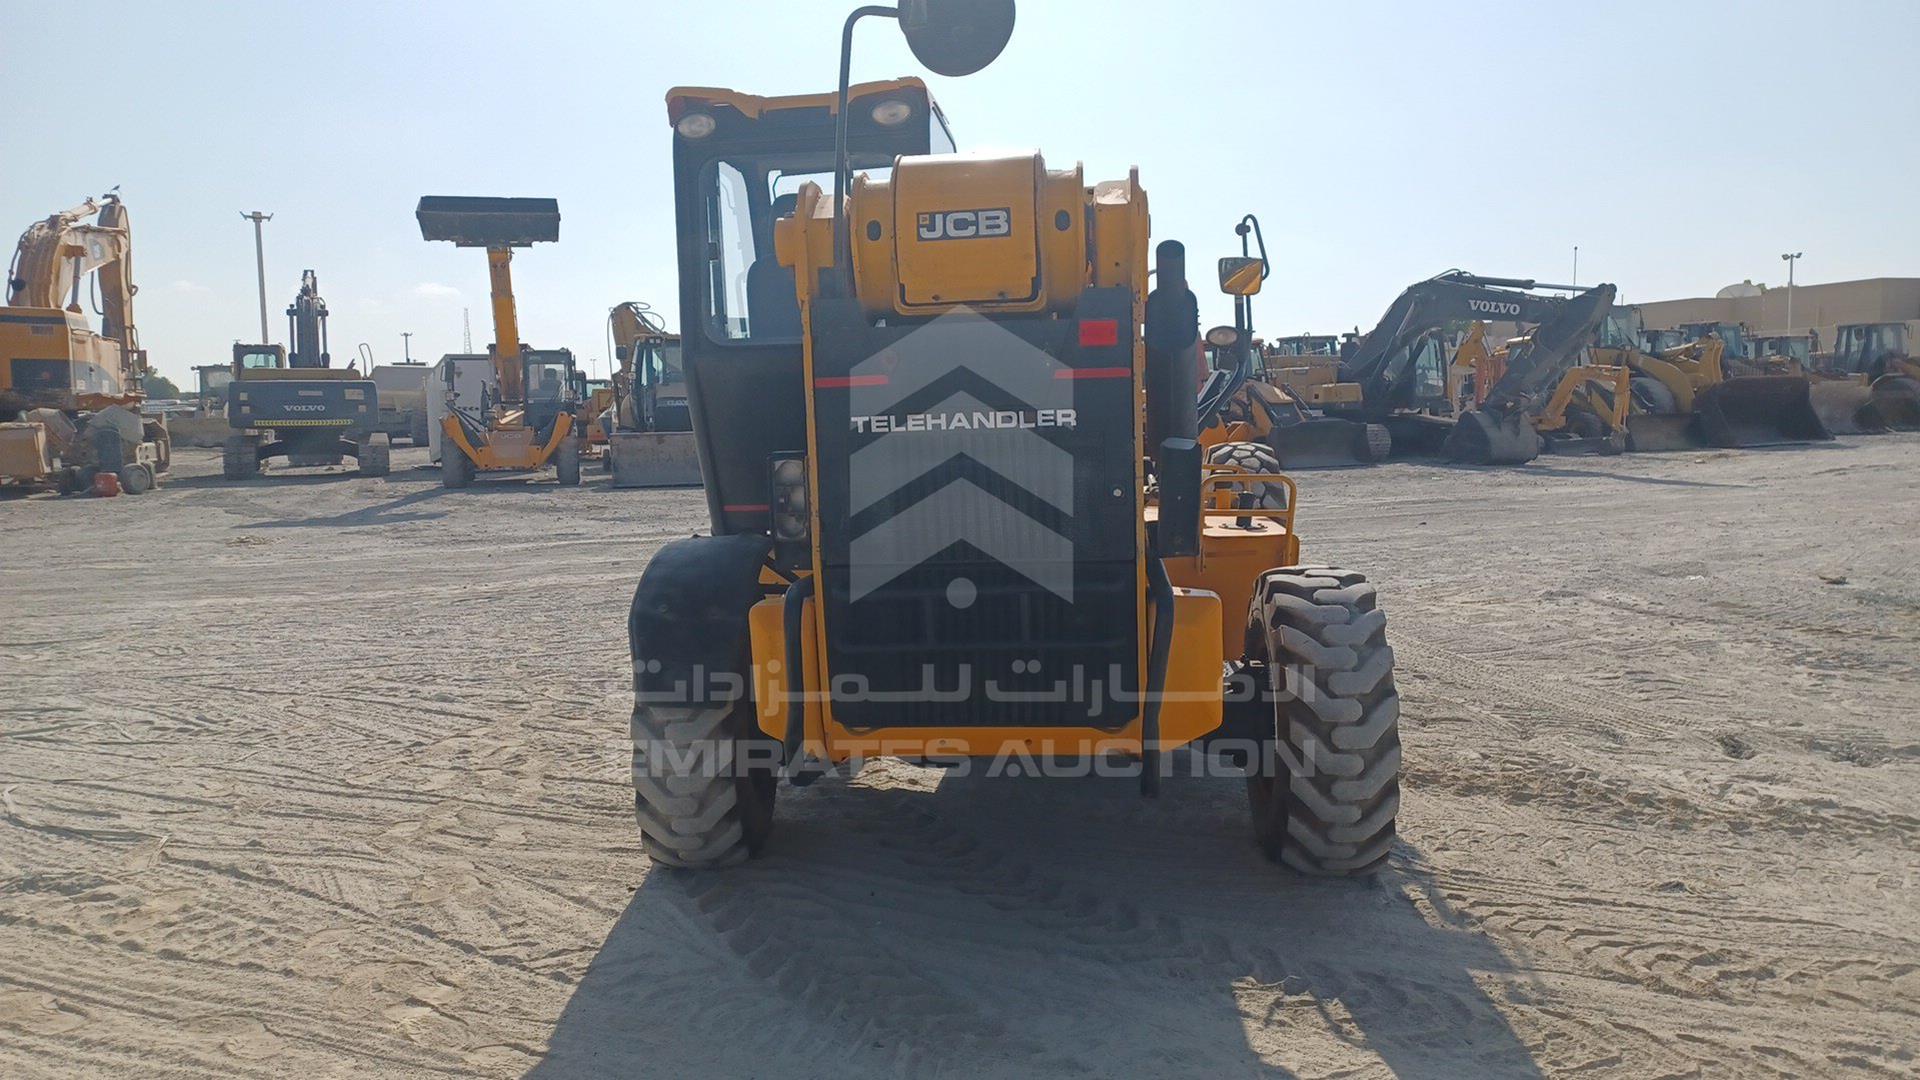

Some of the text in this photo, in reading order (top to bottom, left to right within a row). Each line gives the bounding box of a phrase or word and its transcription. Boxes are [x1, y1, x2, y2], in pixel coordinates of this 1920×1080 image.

[918, 209, 1009, 239] JCB
[1468, 299, 1520, 315] VOLVO
[284, 404, 326, 412] VOLVO
[850, 408, 1078, 434] TELEHANDLER
